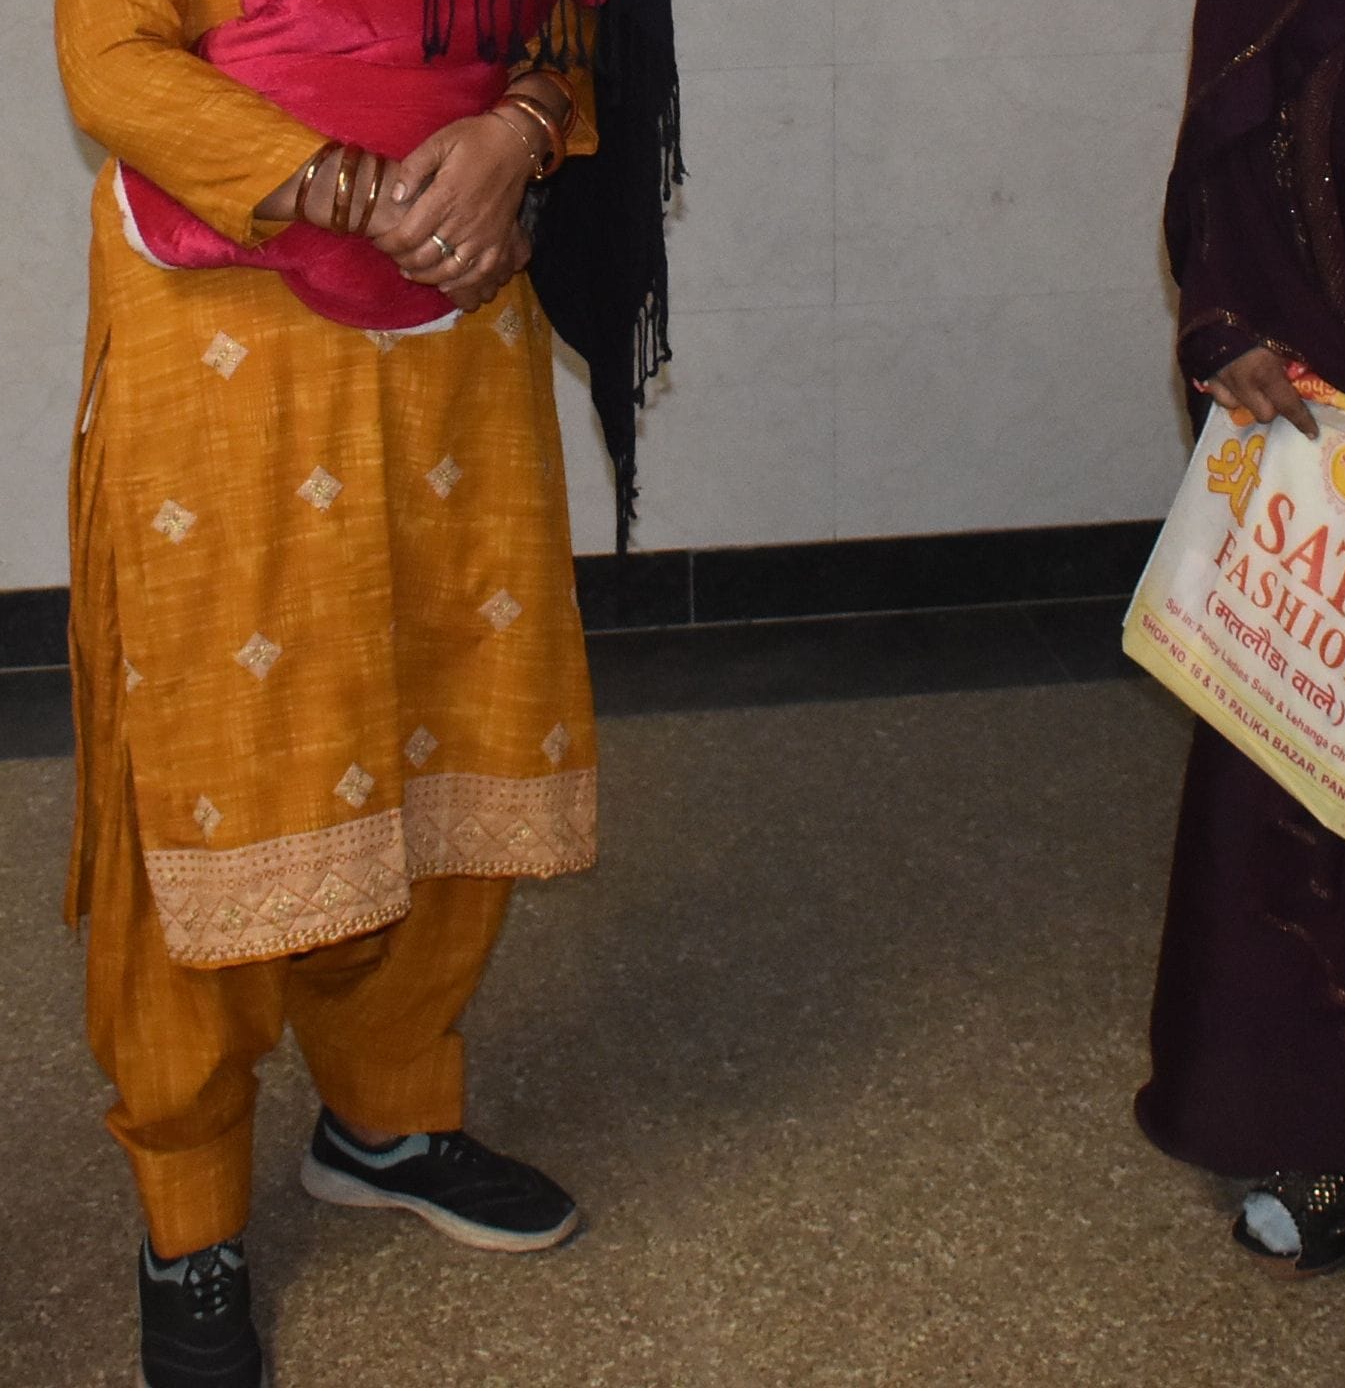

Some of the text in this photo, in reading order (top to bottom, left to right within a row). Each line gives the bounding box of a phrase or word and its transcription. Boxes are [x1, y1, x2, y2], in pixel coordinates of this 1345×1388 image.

[1143, 614, 1169, 644] SHOP
[1202, 675, 1212, 688] &
[1229, 699, 1270, 742] PALIKA
[1276, 700, 1285, 713] &
